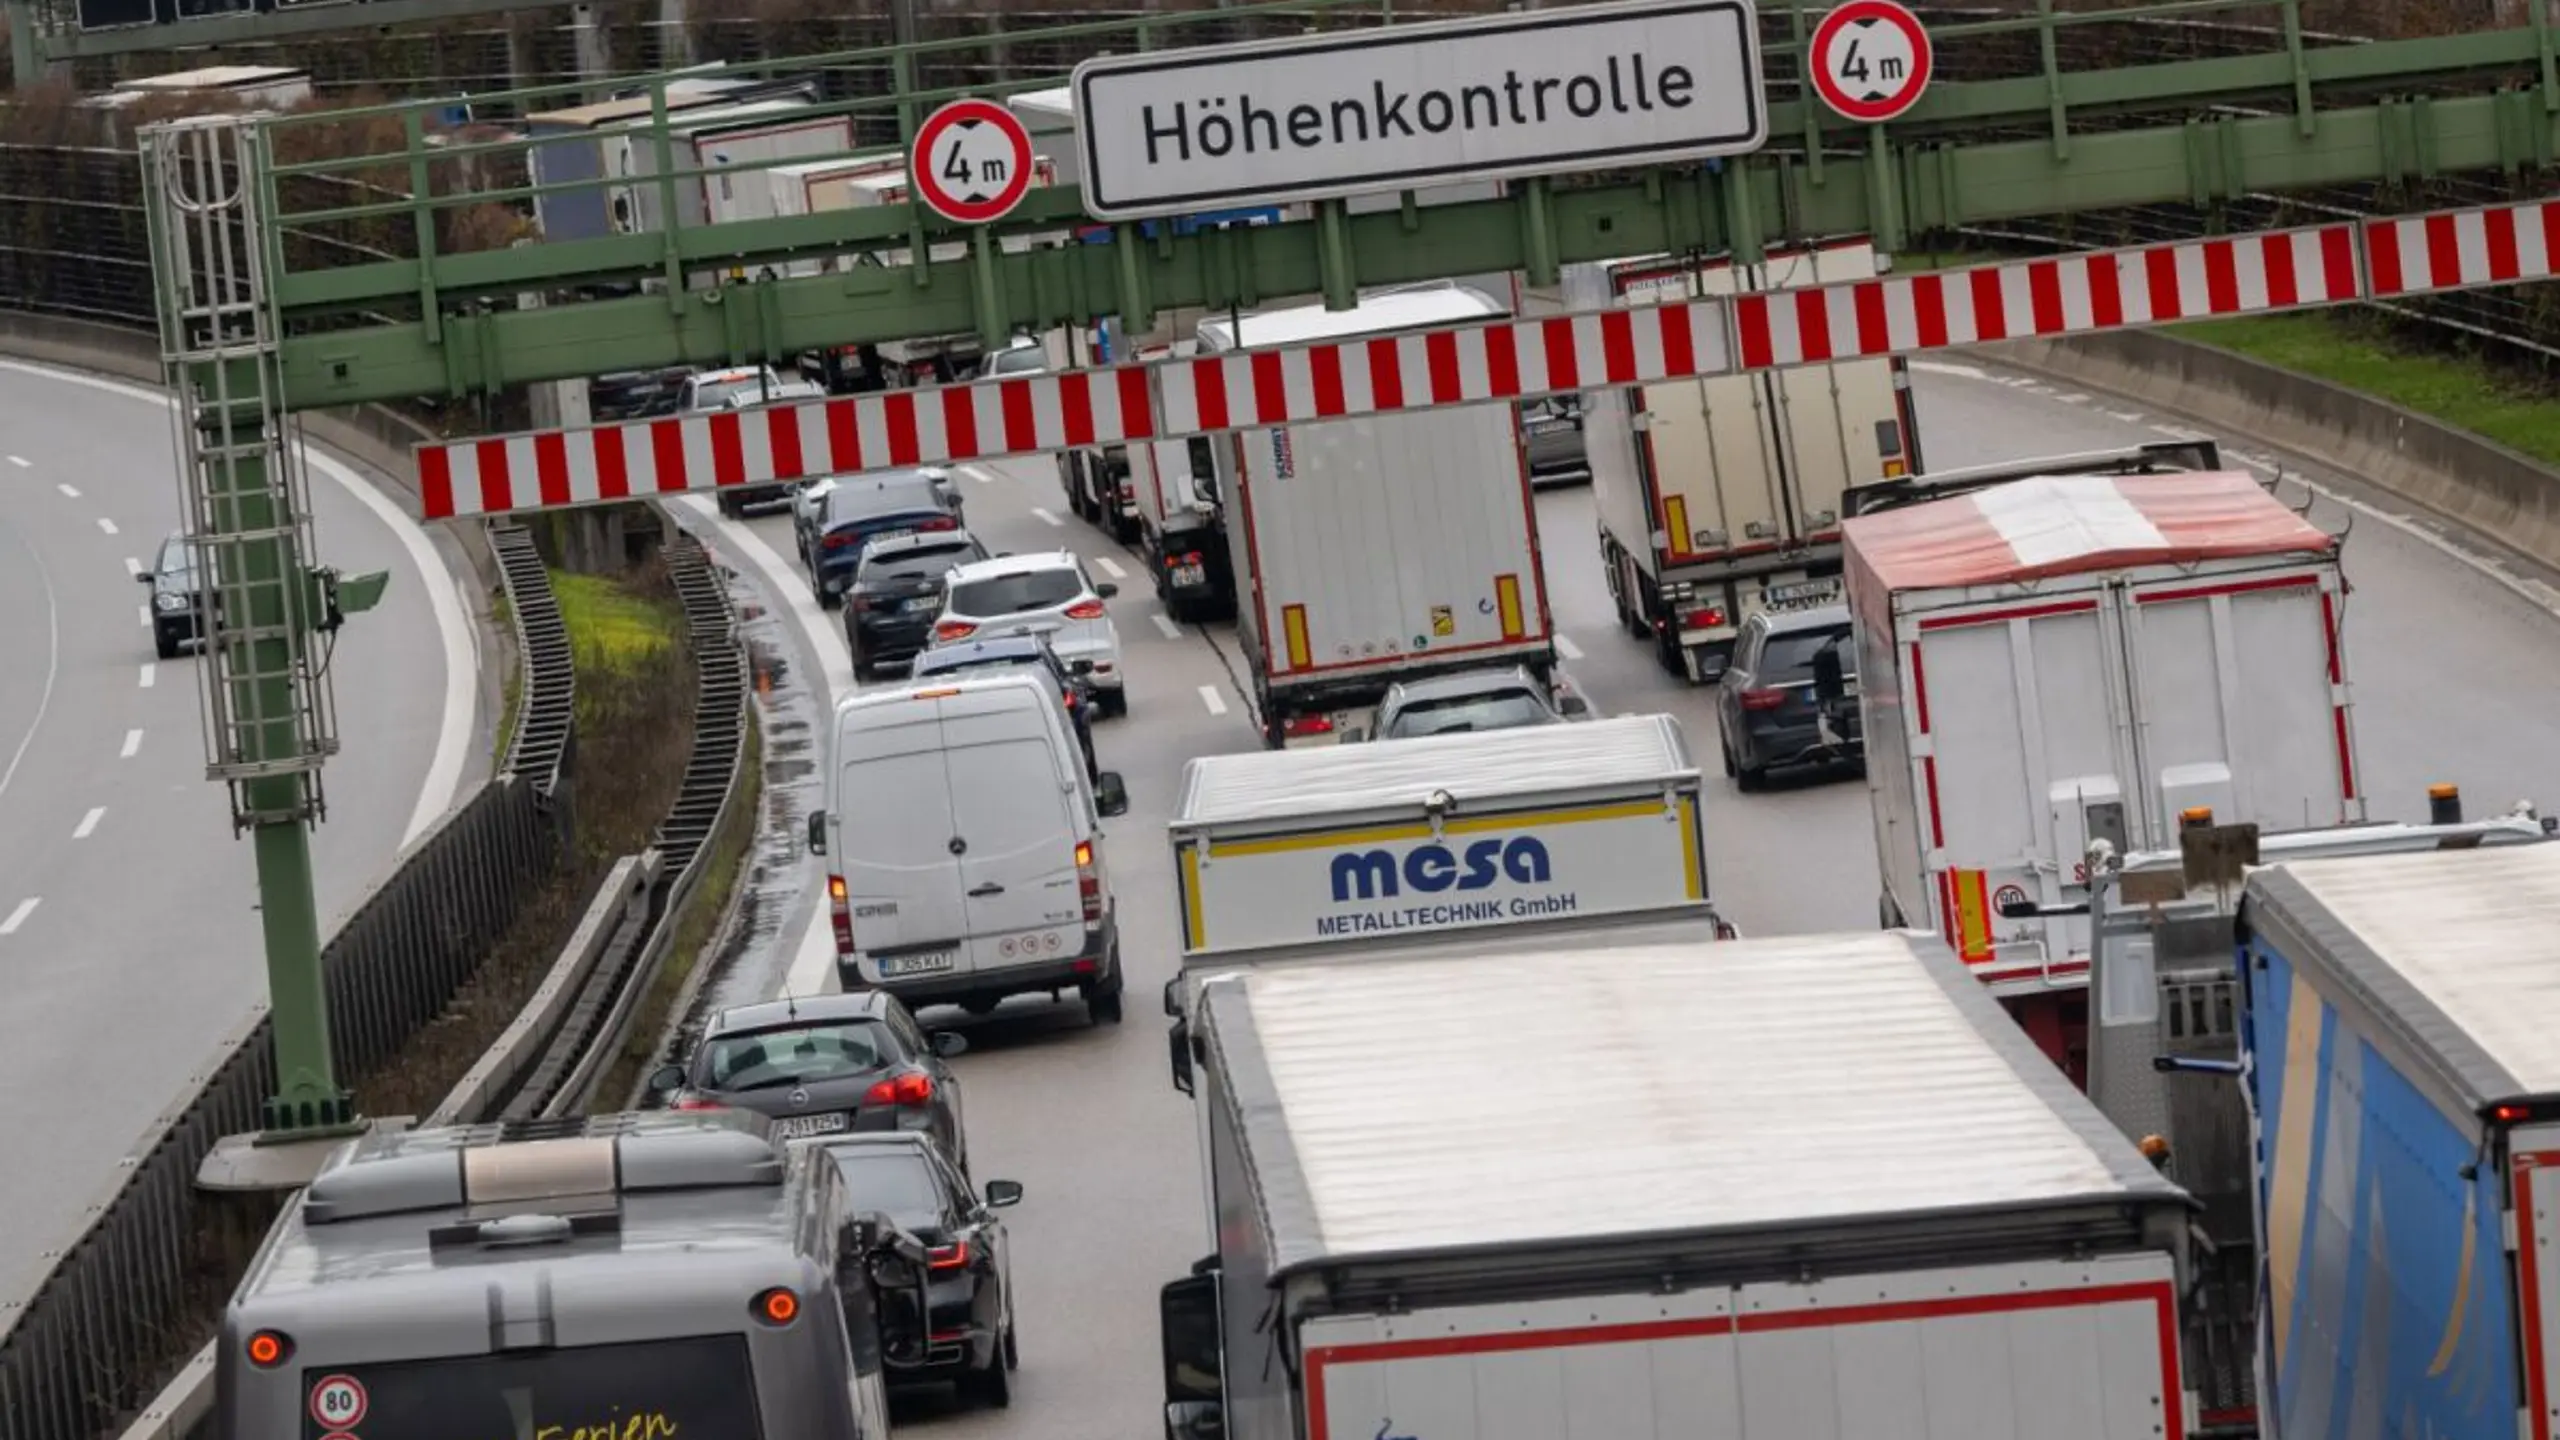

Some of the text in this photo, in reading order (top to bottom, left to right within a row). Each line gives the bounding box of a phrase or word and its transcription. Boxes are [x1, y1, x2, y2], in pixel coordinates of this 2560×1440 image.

[1842, 38, 1903, 82] 4 m
[1142, 53, 1695, 164] Höhenkontrolle
[944, 139, 1005, 184] 4 m
[1331, 835, 1552, 903] mesa
[1317, 892, 1577, 936] METALLTECHNIK GmbH
[326, 1390, 353, 1412] 80
